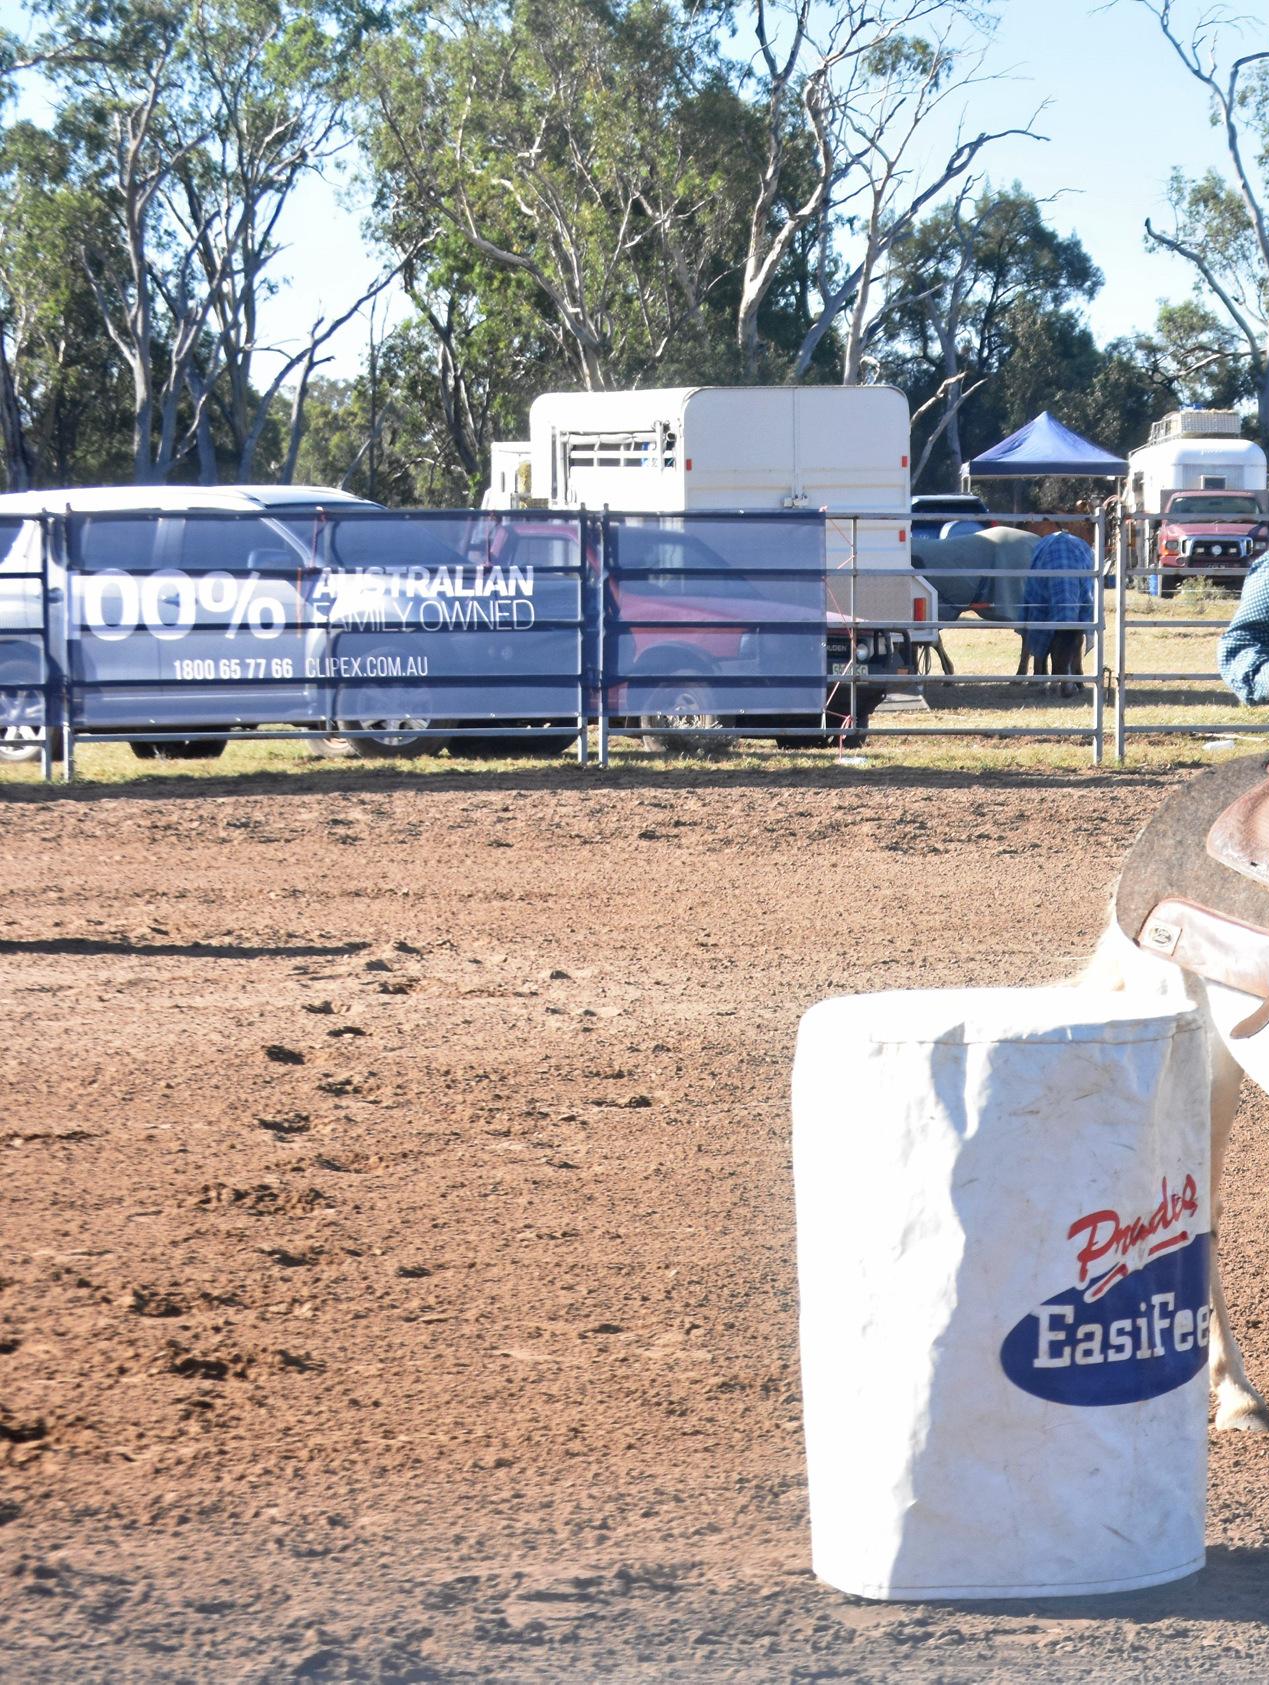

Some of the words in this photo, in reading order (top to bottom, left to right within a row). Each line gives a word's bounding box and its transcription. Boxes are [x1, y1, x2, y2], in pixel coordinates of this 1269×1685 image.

[312, 565, 535, 599] AUSTRALIAN
[313, 600, 413, 633] FAMILY
[419, 599, 535, 631] OWNED
[173, 659, 215, 680] 1800
[219, 659, 241, 679] 65
[245, 658, 267, 679] 77
[271, 658, 293, 679] 66
[305, 656, 429, 678] CLIPEX.COM.AU
